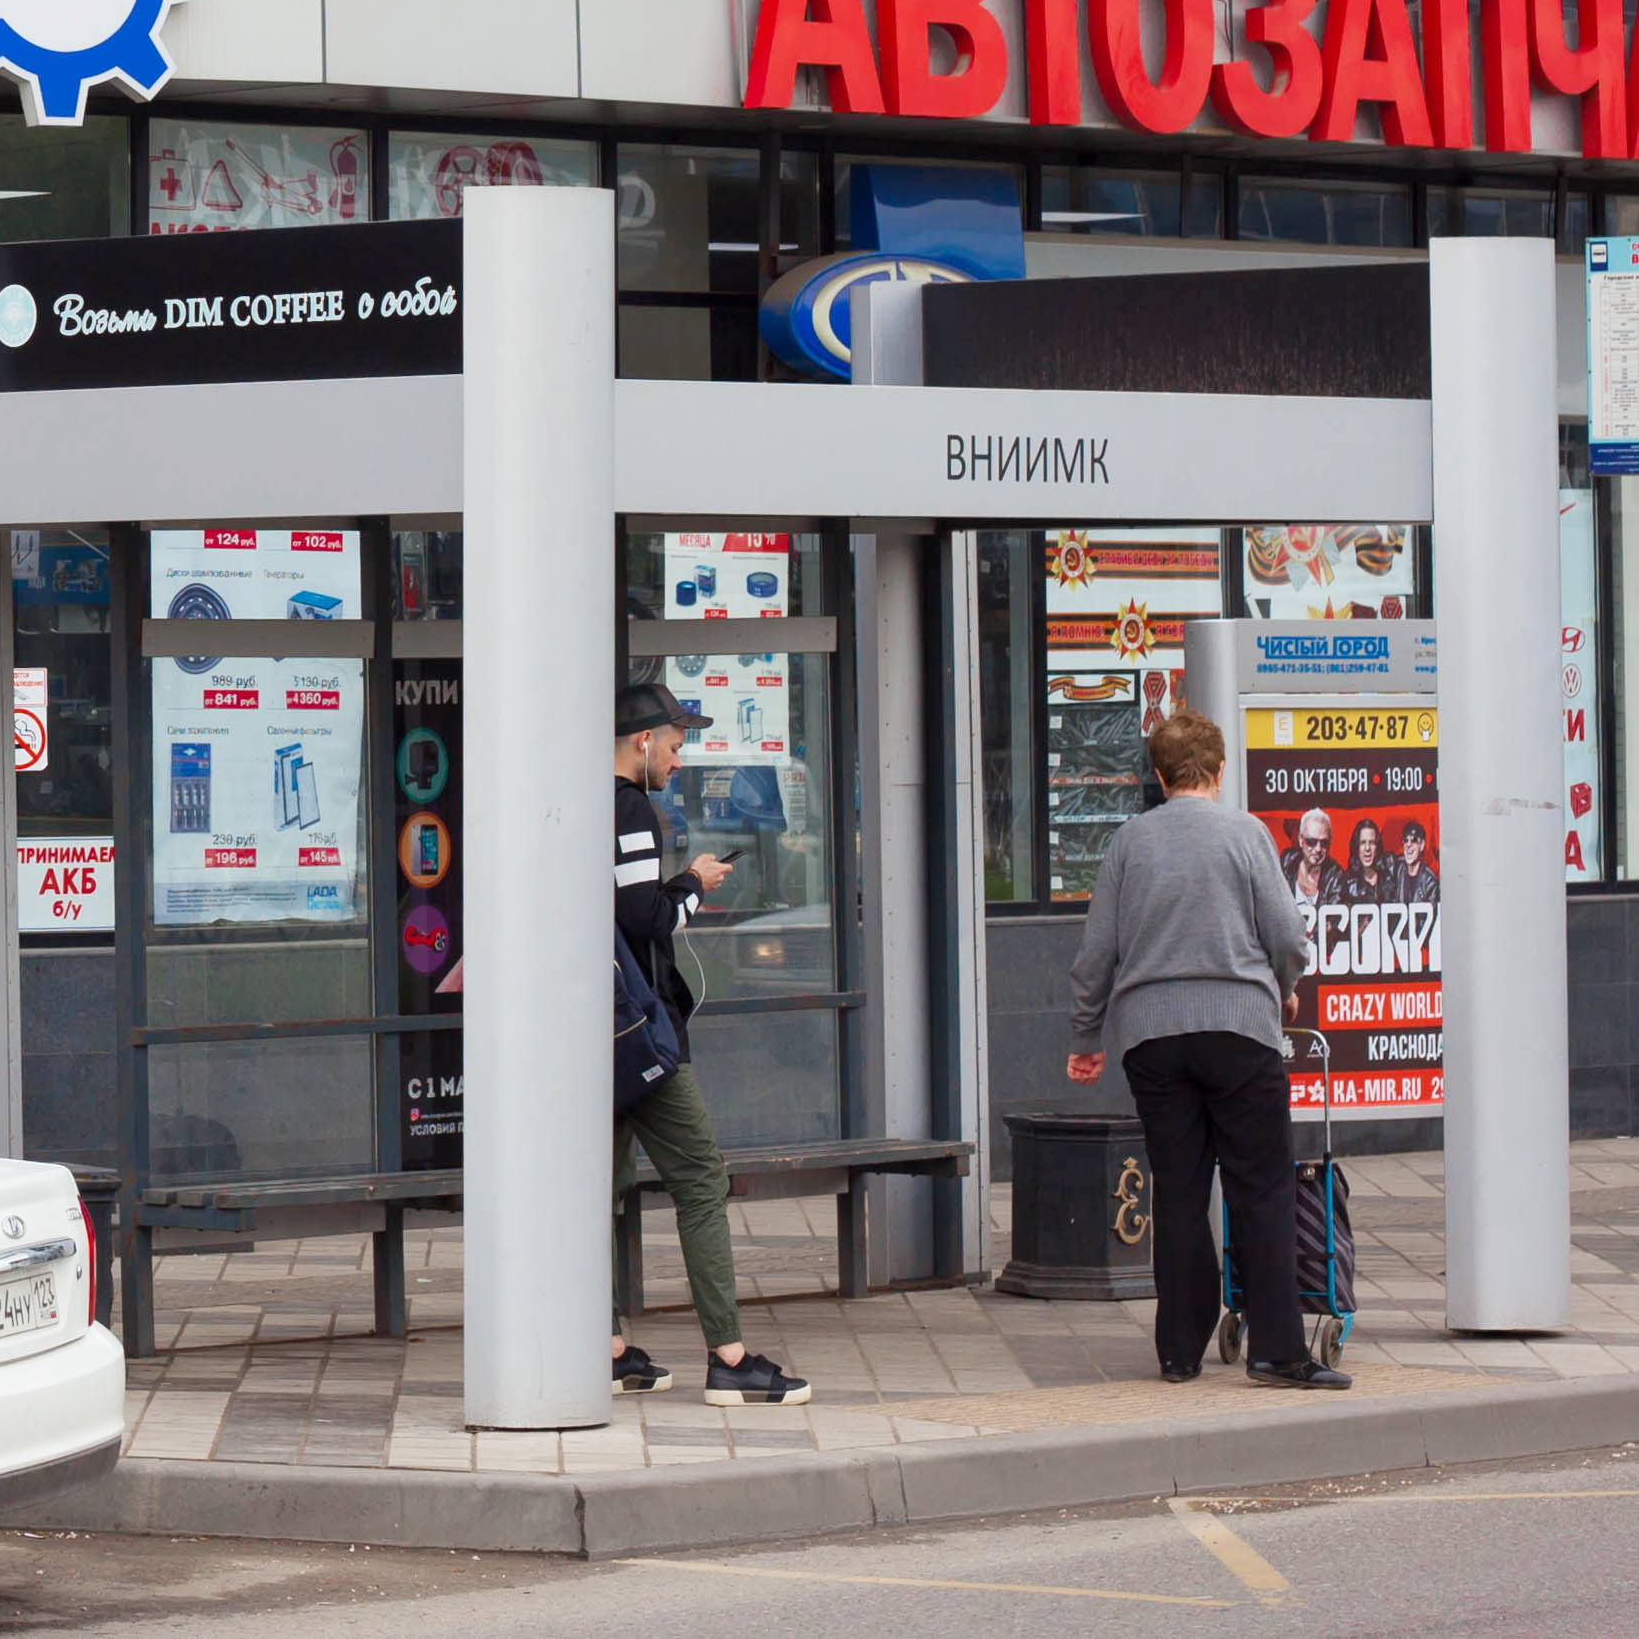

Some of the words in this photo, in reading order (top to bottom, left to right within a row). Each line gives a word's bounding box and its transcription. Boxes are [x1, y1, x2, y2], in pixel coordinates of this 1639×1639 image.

[53, 293, 157, 336] Возьми
[164, 297, 223, 329] DIM
[230, 290, 344, 327] COFFEE
[380, 276, 458, 317] собой
[945, 433, 1110, 485] ВНИИМК
[216, 533, 240, 545] 124
[304, 535, 326, 547] 102
[215, 693, 237, 705] 841
[395, 678, 459, 707] КУПИ
[1265, 768, 1288, 793] 30
[1293, 768, 1368, 793] ОКТЯБРЯ
[1385, 766, 1423, 792] 19:00
[310, 851, 326, 862] 145
[39, 867, 97, 895] АКБ
[307, 885, 338, 898] LADA
[52, 900, 82, 921] б/у
[1326, 993, 1385, 1022] CRAZY
[1390, 991, 1443, 1020] WORLD
[407, 1077, 423, 1100] С
[426, 1077, 436, 1098] 1
[410, 1123, 456, 1136] УСЛОВИЯ
[34, 1277, 55, 1309] 123
